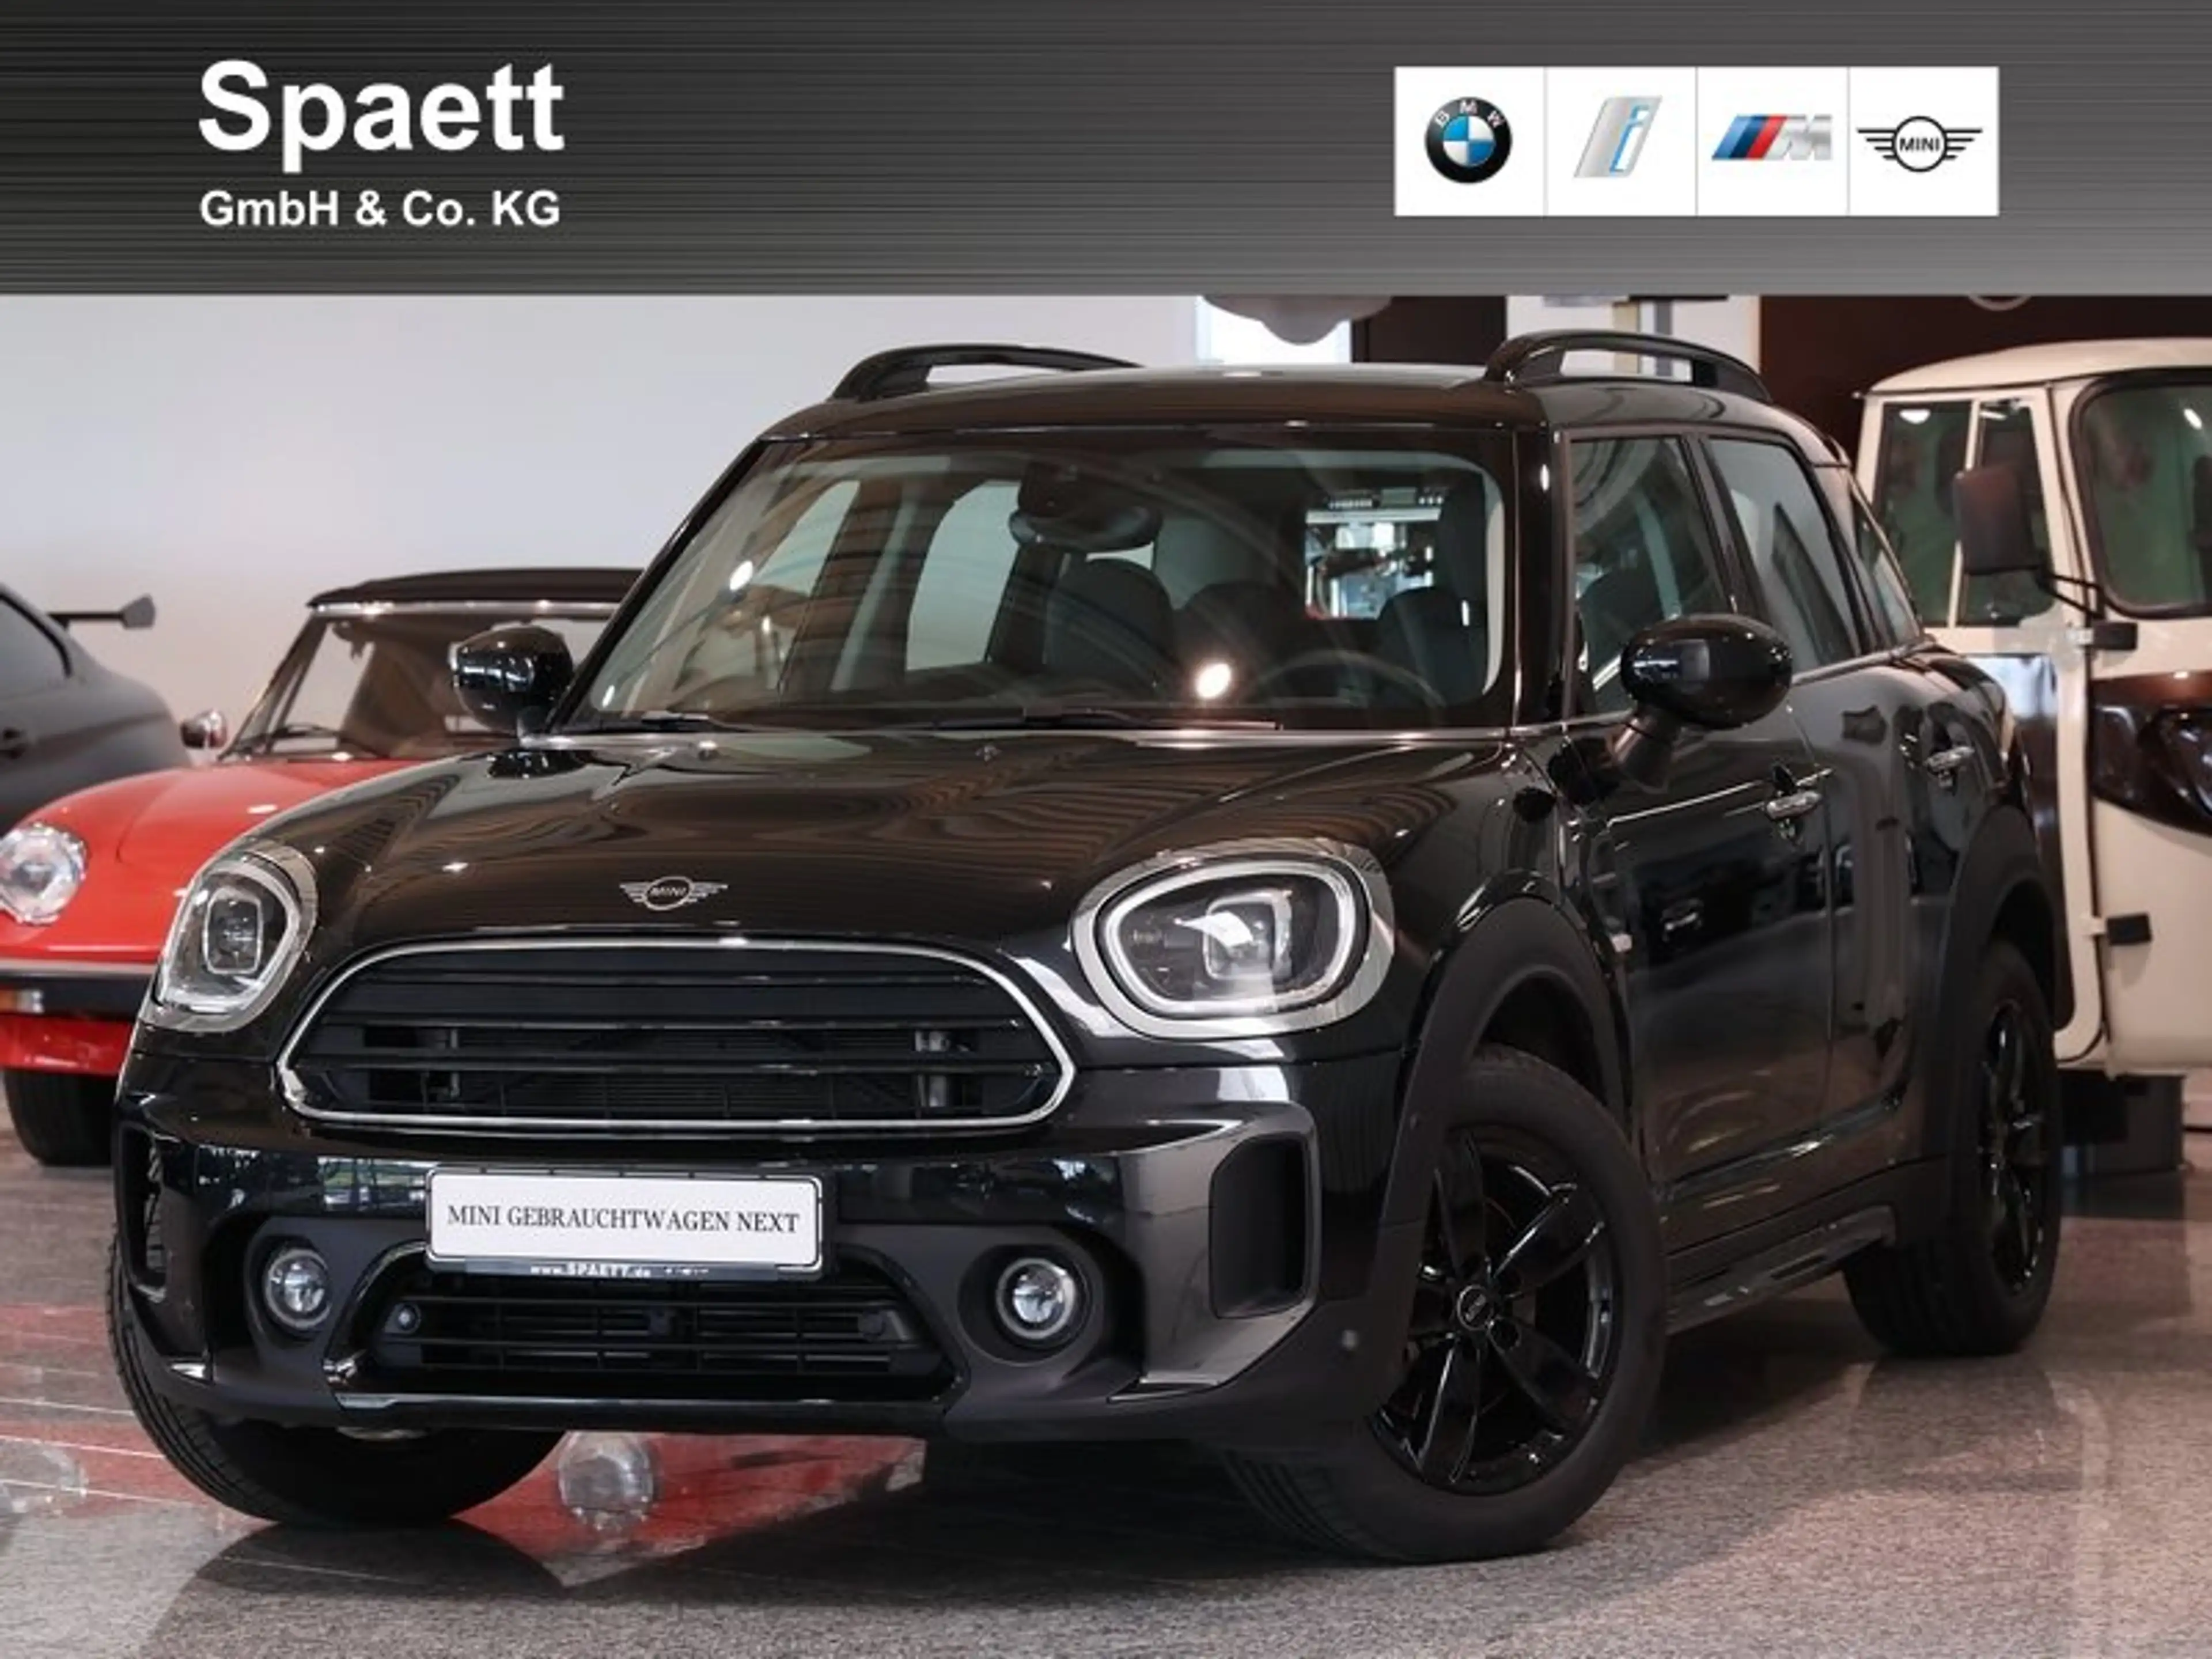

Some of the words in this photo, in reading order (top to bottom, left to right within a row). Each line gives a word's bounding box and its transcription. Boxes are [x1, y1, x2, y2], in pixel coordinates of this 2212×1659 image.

[448, 1205, 501, 1226] MINI
[507, 1207, 729, 1232] GEBRAUCHTWAGEN
[737, 1212, 801, 1233] NEXT
